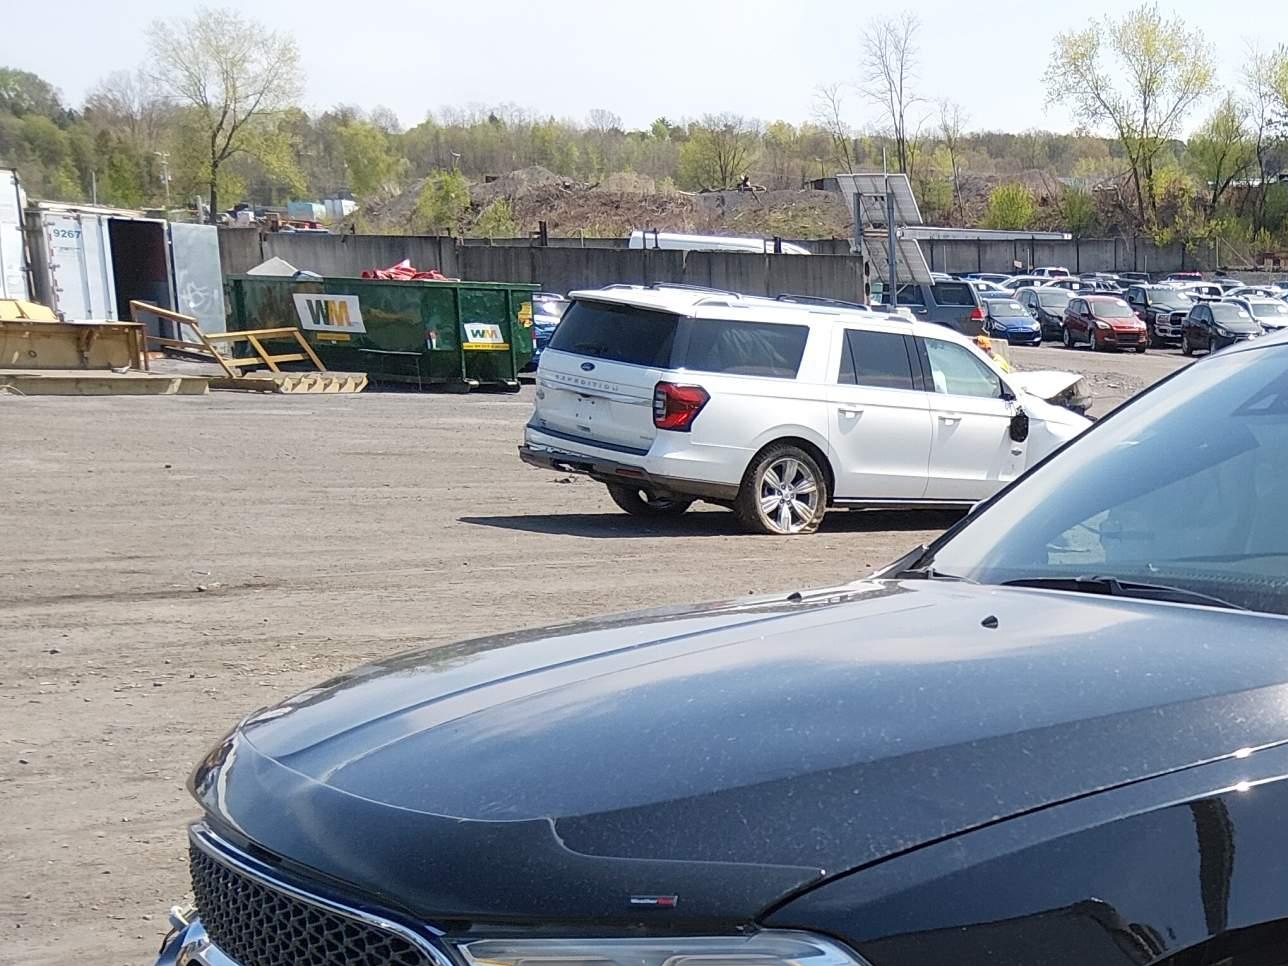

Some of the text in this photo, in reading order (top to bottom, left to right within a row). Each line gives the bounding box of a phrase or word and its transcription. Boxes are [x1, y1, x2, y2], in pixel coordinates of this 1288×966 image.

[53, 229, 81, 239] 9267
[305, 299, 352, 326] WM
[471, 329, 498, 338] WM
